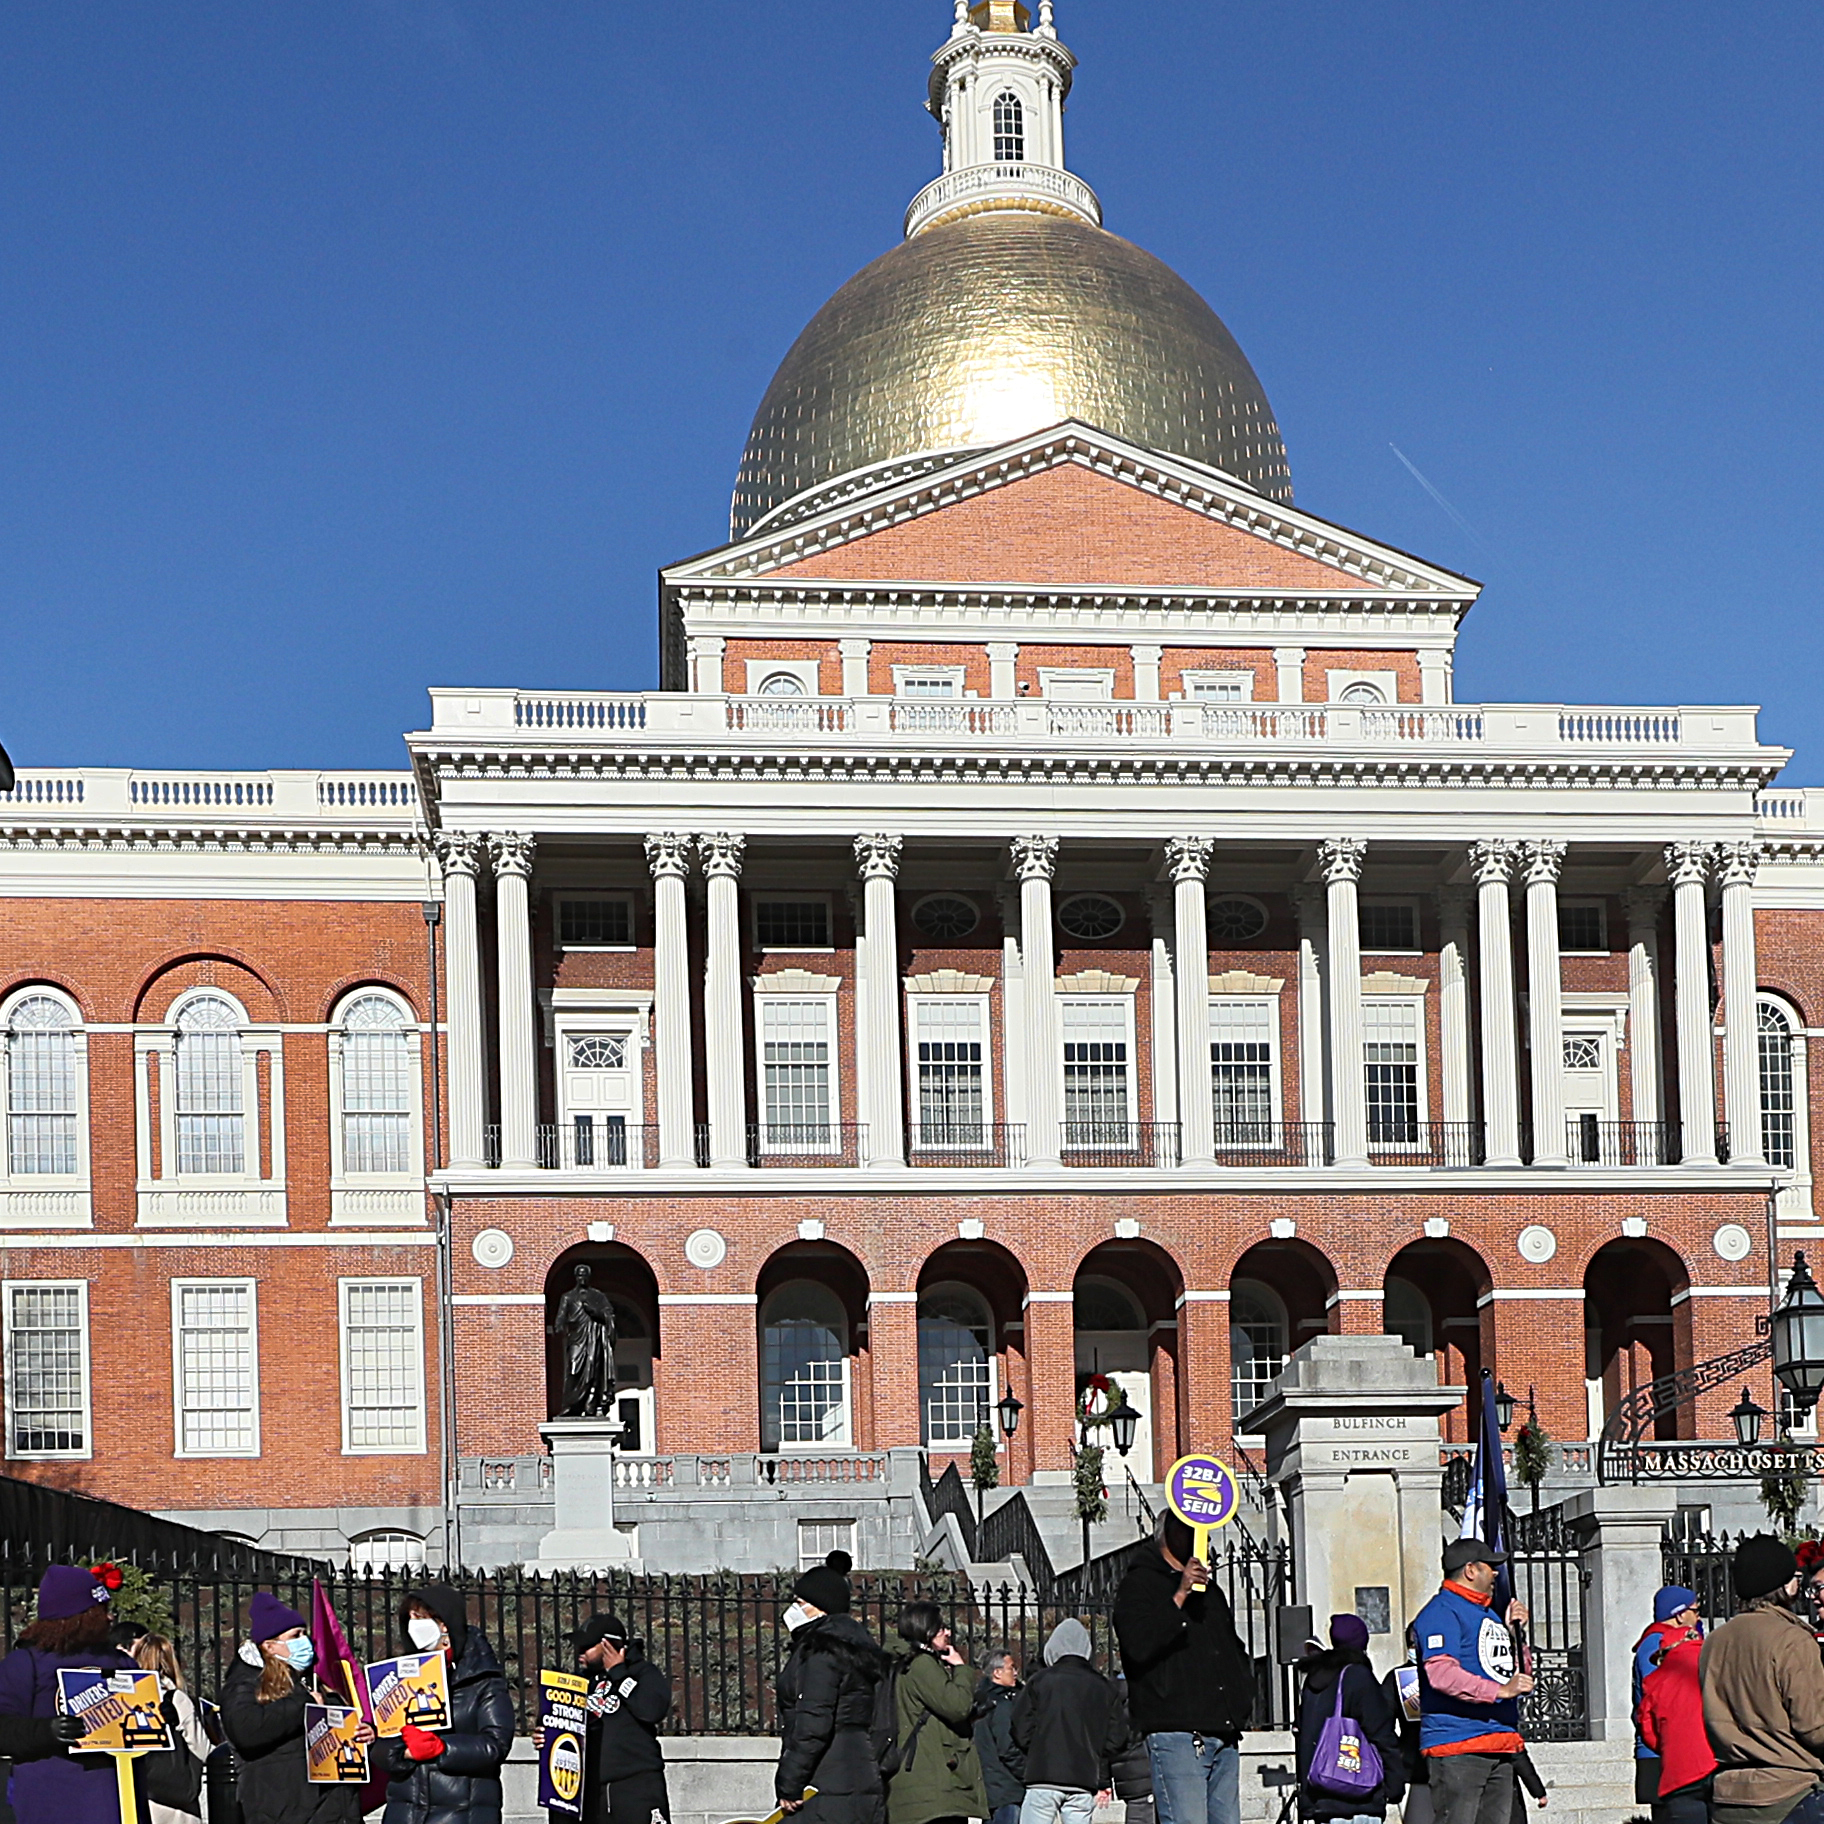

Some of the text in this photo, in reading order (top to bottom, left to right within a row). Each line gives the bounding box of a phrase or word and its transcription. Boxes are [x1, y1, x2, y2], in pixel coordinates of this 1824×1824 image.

[1333, 1418, 1407, 1429] BULFINCH
[1332, 1449, 1410, 1460] ENTRANCE
[1645, 1452, 1824, 1471] MASSACHUSETTS
[1181, 1465, 1223, 1483] 32BJ
[1181, 1499, 1222, 1516] SEIU
[371, 1670, 399, 1706] DRIVERS
[545, 1688, 572, 1704] GOOD
[68, 1682, 109, 1714] DRIVERS
[377, 1684, 408, 1724] UNITED
[552, 1703, 584, 1722] STRONG
